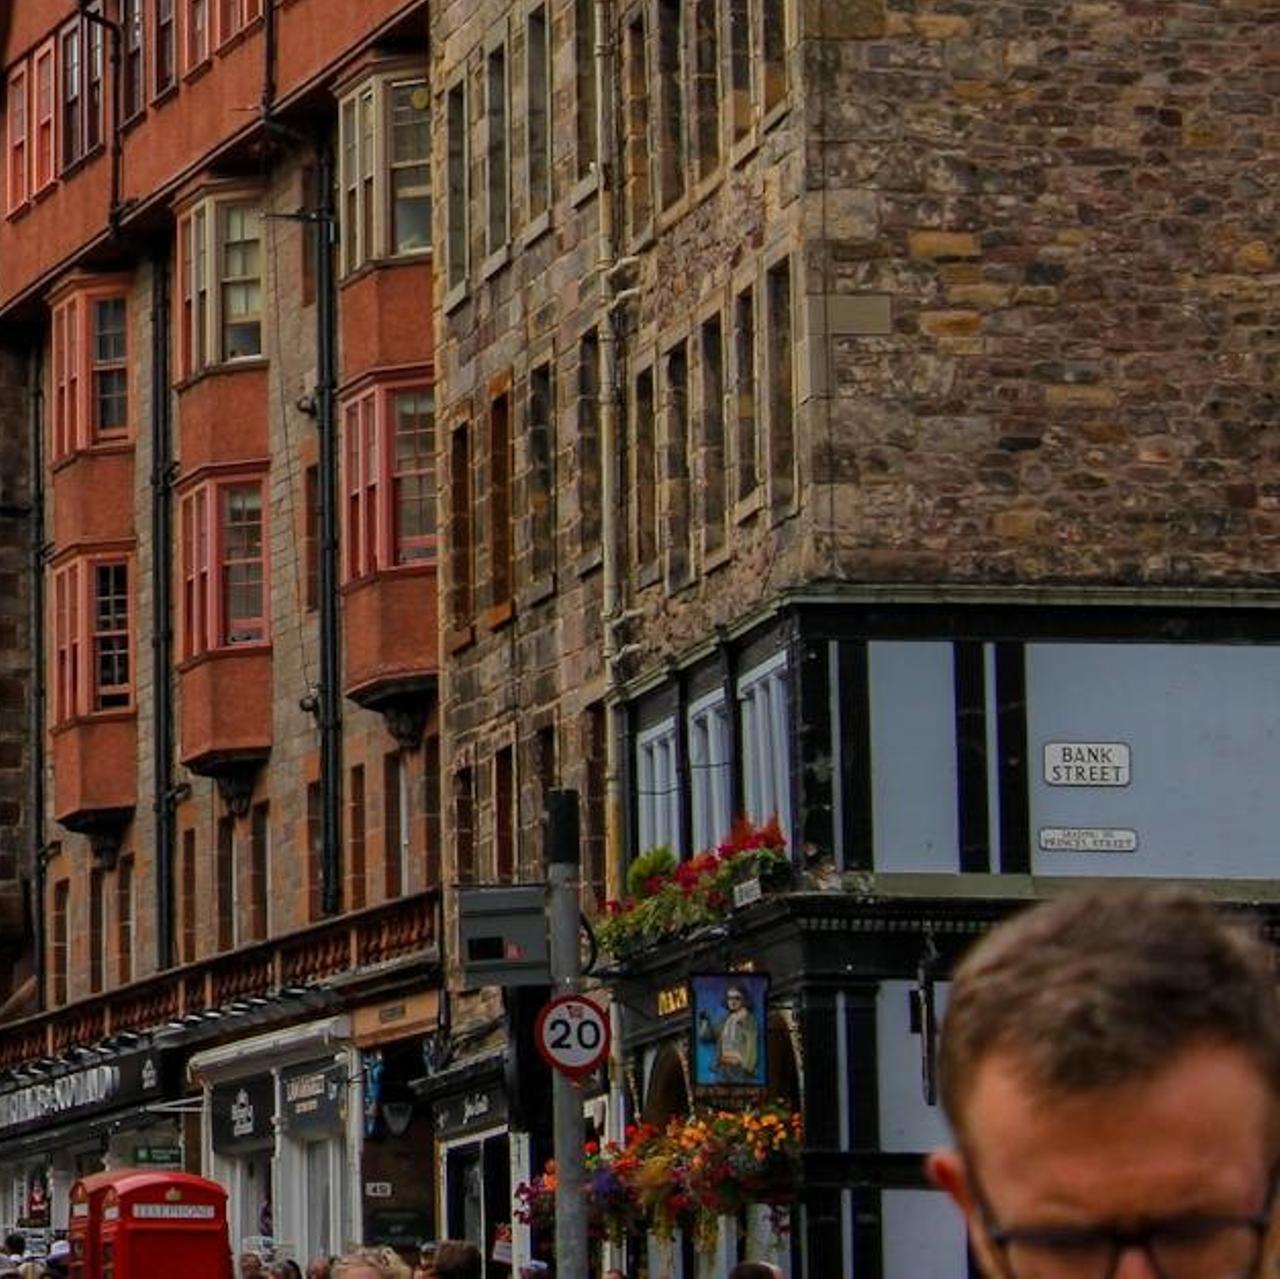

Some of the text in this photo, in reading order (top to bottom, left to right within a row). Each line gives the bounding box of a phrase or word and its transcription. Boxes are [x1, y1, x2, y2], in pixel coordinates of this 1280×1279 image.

[1062, 747, 1112, 763] BANK
[1052, 766, 1126, 782] STREET
[550, 1019, 601, 1050] 20
